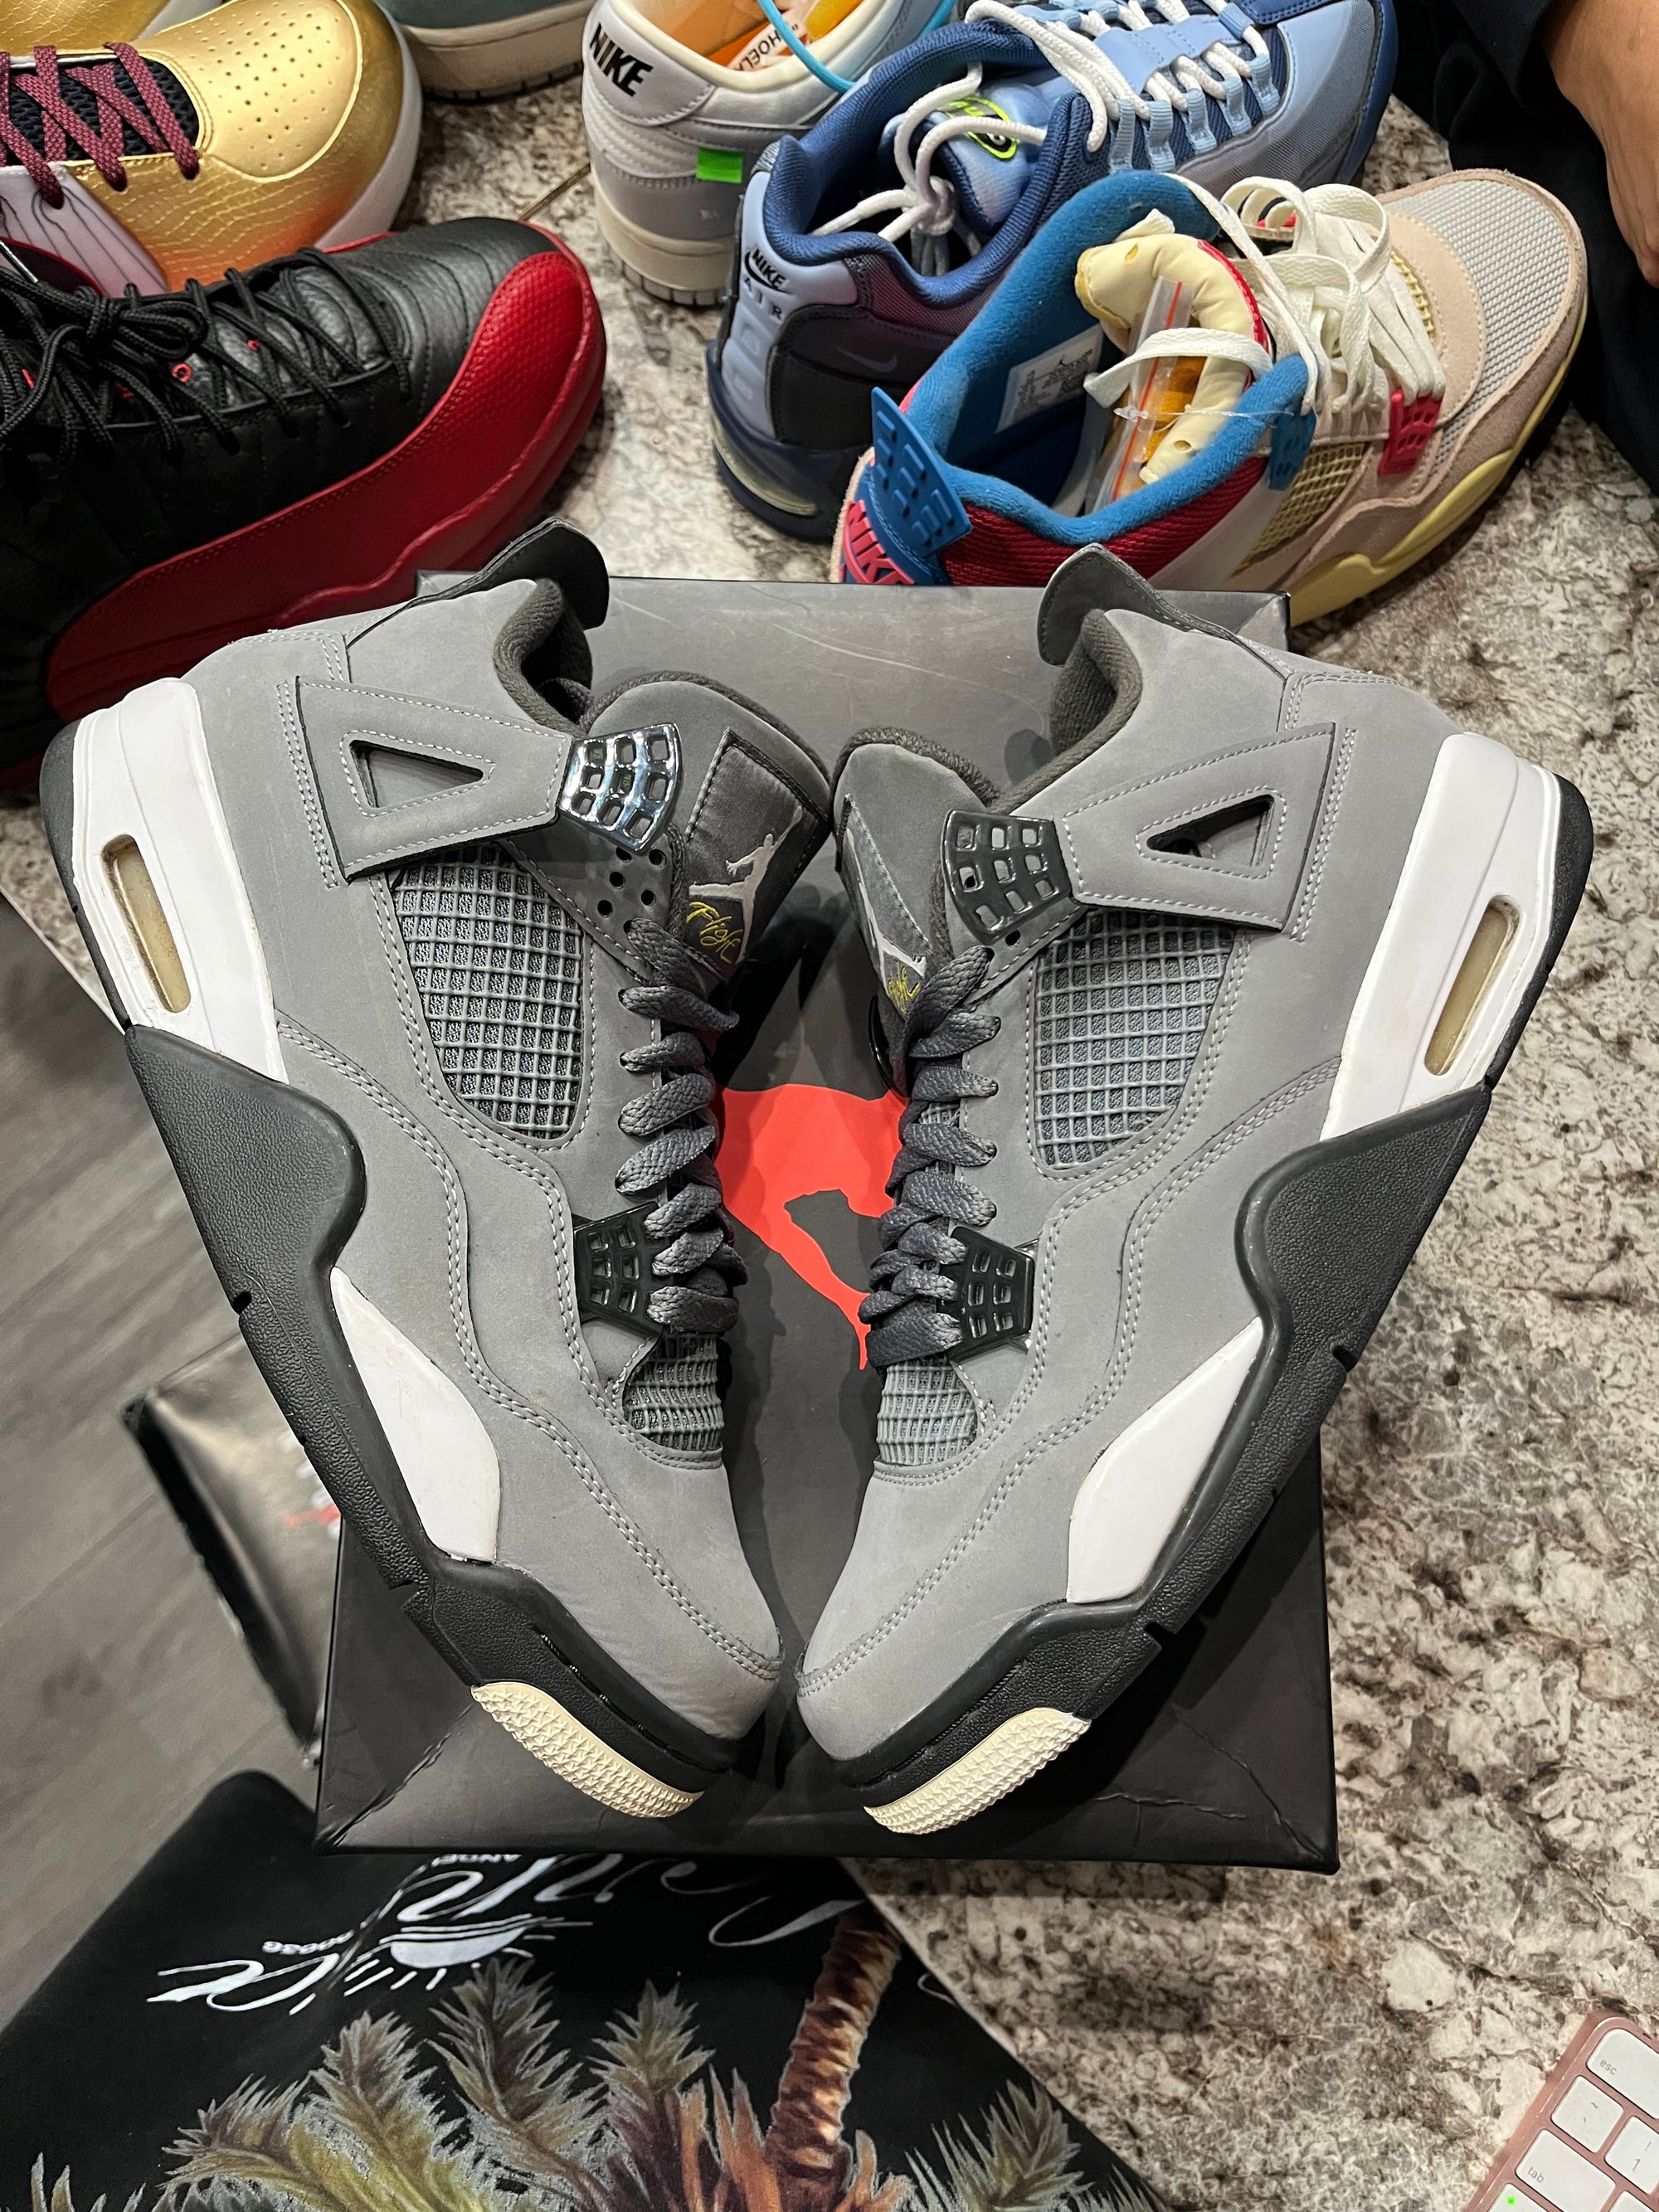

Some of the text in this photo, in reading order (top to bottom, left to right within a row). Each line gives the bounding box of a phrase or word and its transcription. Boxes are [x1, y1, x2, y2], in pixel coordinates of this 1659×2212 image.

[589, 22, 654, 97] NIKE
[752, 248, 786, 289] NIKE
[744, 277, 782, 320] AIR
[686, 901, 743, 964] Flight
[1599, 2059, 1618, 2076] esc
[1526, 2166, 1545, 2184] tab
